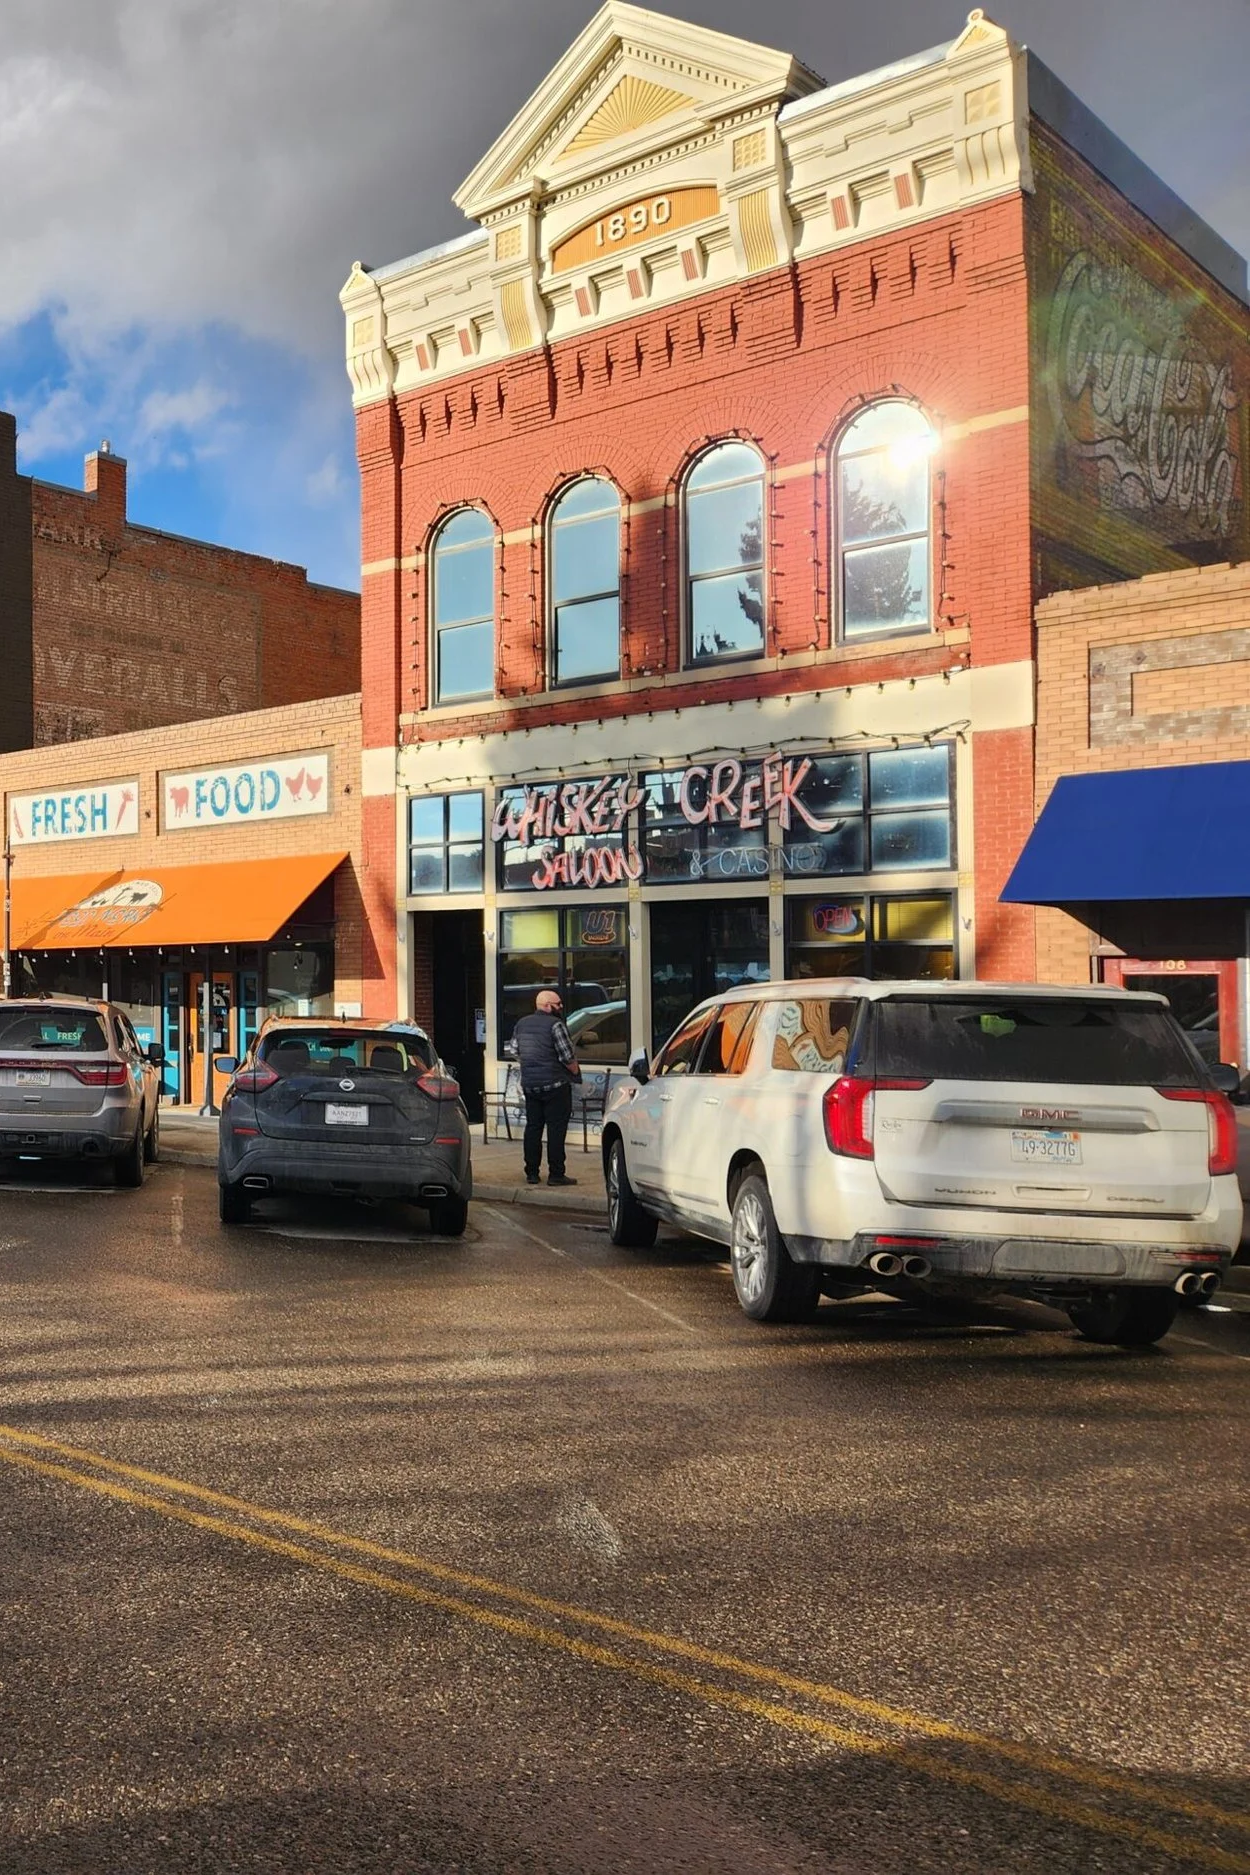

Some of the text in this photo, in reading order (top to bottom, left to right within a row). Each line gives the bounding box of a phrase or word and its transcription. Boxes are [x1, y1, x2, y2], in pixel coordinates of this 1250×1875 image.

[595, 197, 671, 247] 1890
[31, 793, 108, 837] FRESH
[195, 769, 282, 819] FOOD
[490, 750, 846, 847] WHISKEY CREEK
[532, 843, 822, 890] SALOON & CASINO
[813, 906, 852, 932] OPEN
[1020, 1108, 1083, 1120] GMC
[1022, 1140, 1076, 1157] 49-3277G
